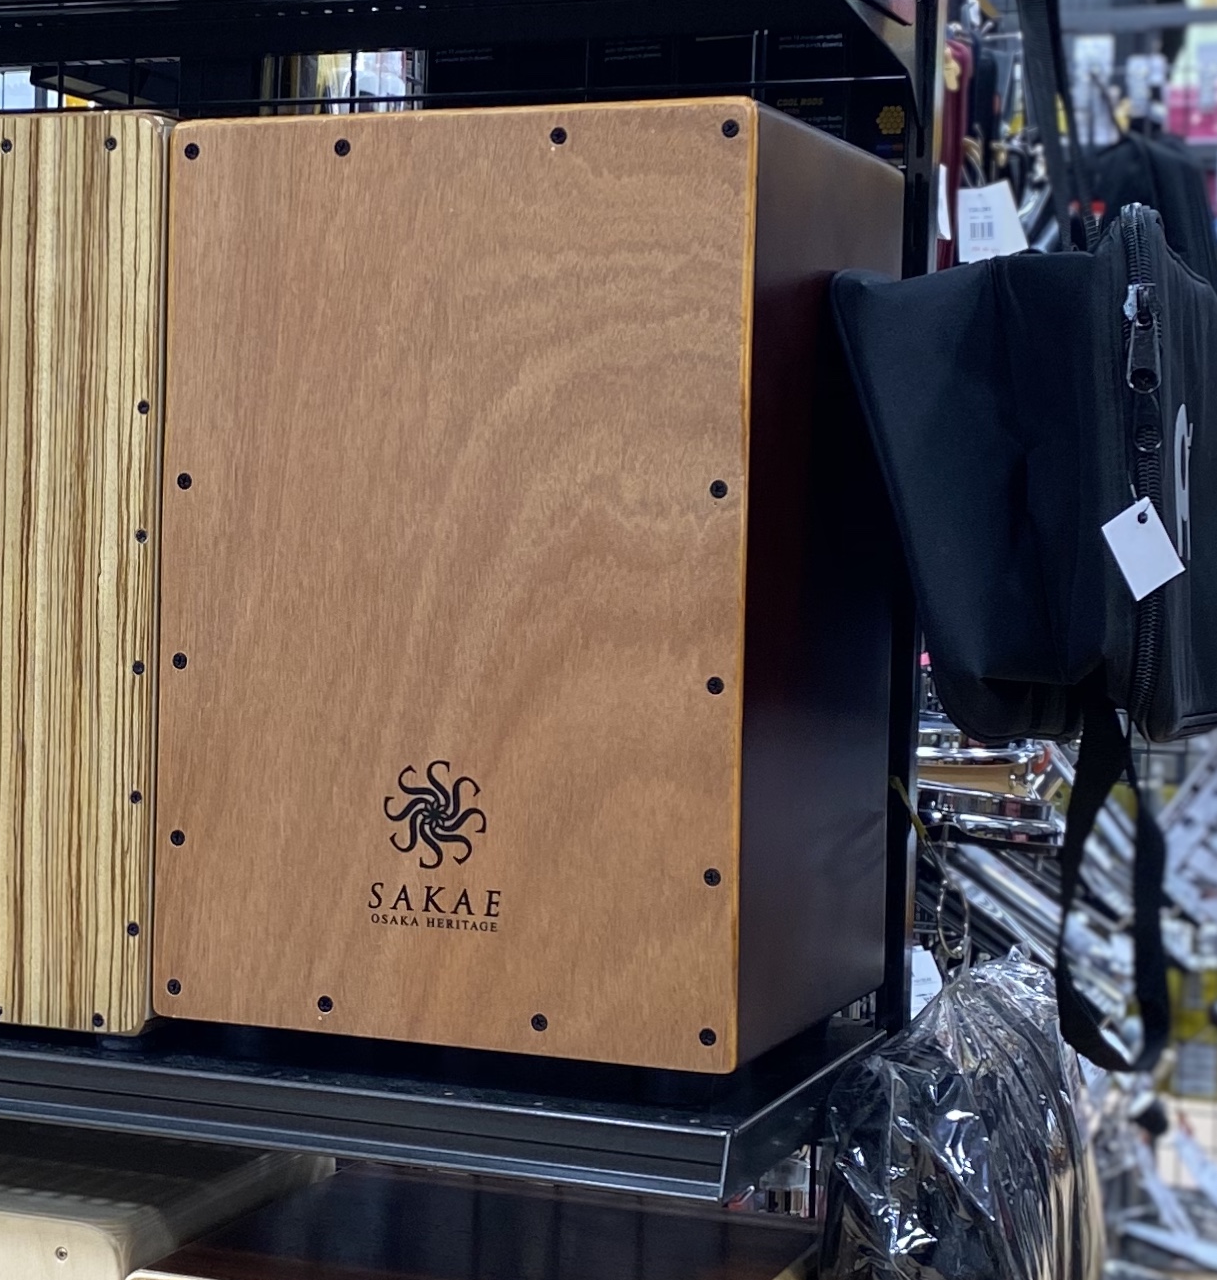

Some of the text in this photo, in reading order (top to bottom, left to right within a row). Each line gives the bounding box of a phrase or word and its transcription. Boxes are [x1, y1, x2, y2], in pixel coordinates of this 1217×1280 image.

[367, 881, 502, 918] SAKAE
[371, 913, 498, 933] OSAKA HERITAGE
